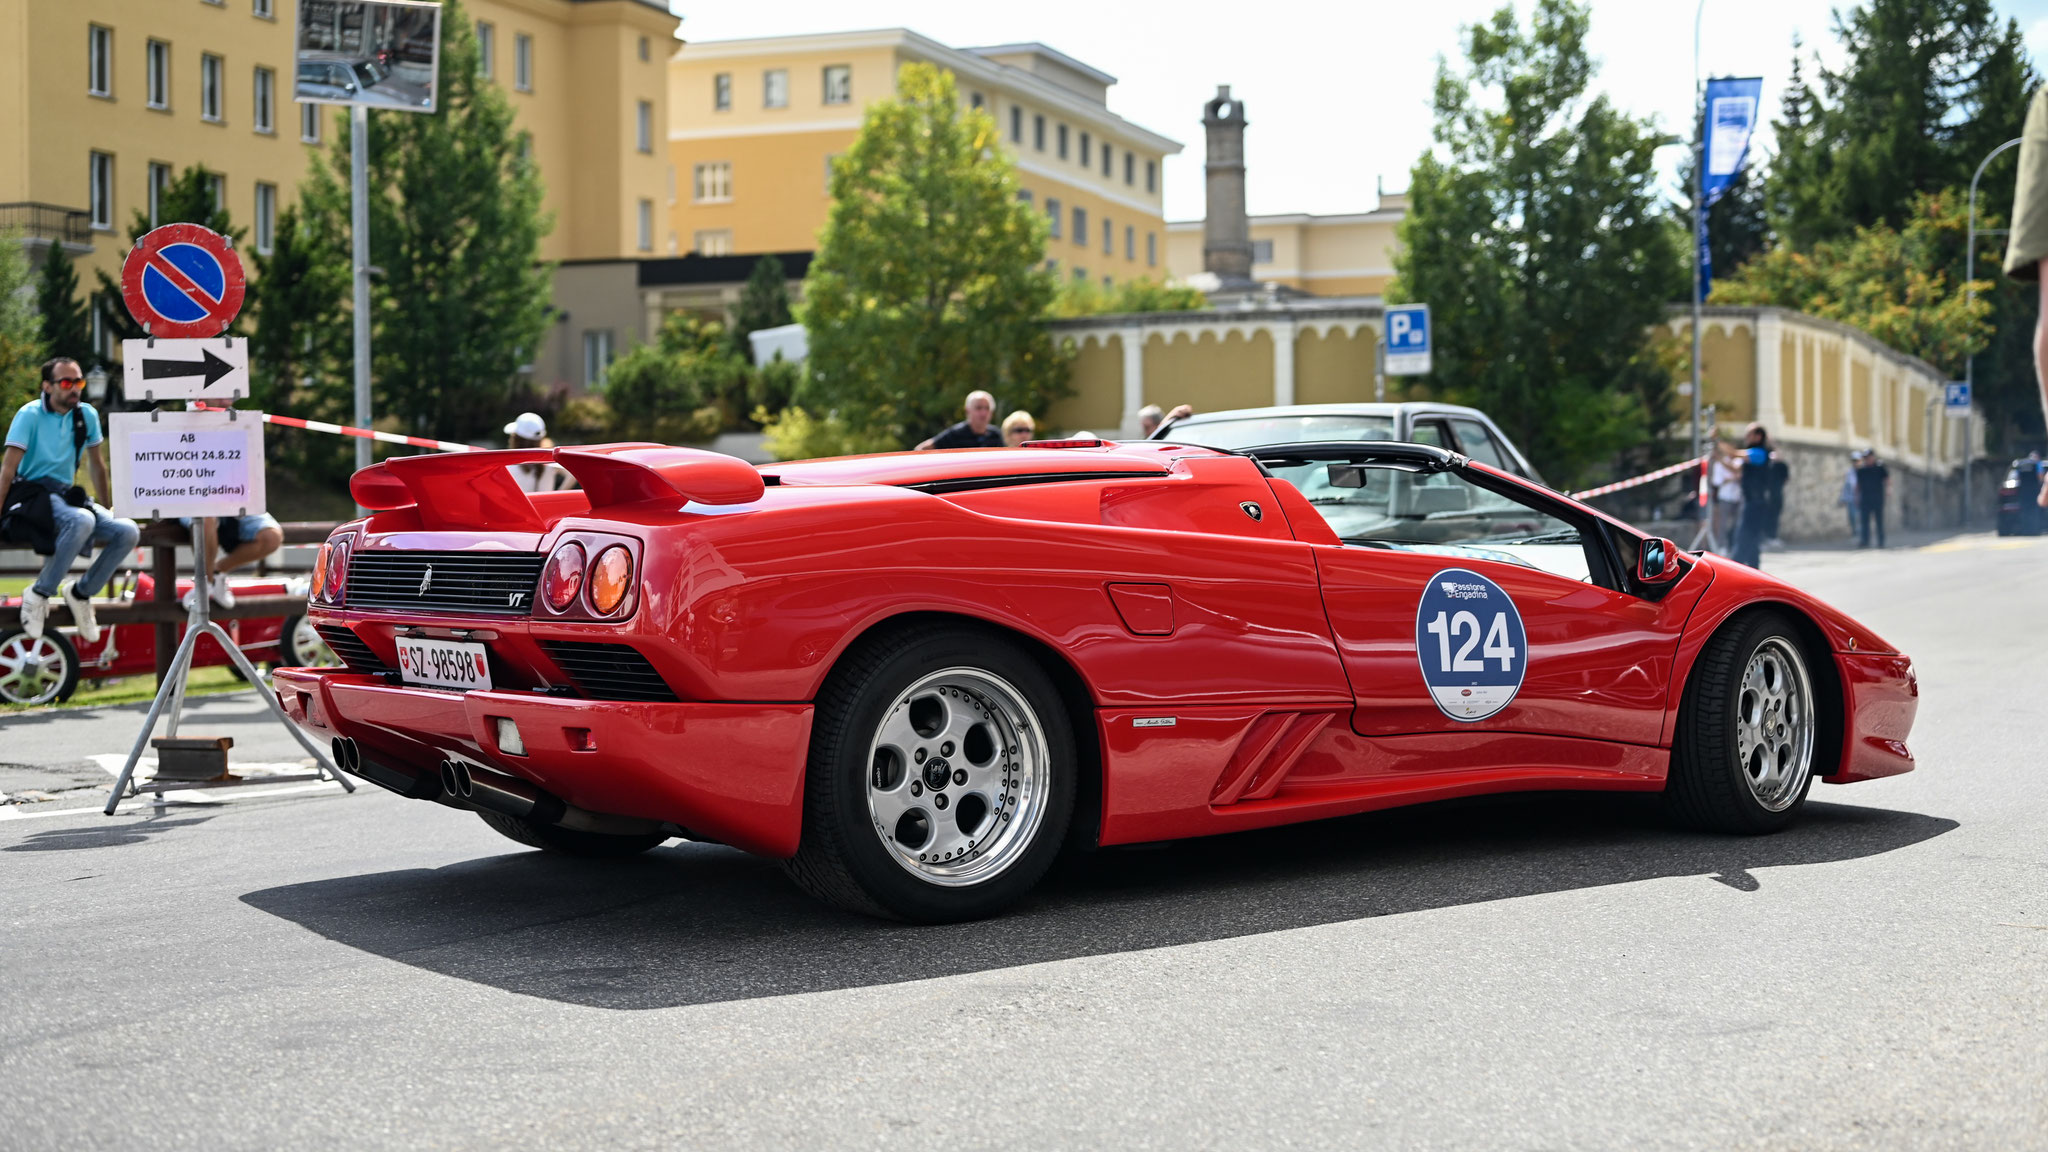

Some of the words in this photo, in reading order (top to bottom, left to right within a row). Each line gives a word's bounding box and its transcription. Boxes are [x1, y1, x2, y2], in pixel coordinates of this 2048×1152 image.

[1390, 313, 1411, 346] P
[180, 433, 196, 443] AB
[135, 450, 199, 461] MITTWOCH
[201, 450, 241, 460] 24.8.22
[162, 468, 193, 479] 07:00
[195, 468, 216, 478] Uhr
[134, 486, 186, 499] (Passione
[189, 484, 245, 497] Engiadina)
[1453, 582, 1487, 591] Passione
[509, 593, 525, 607] VT
[1455, 590, 1488, 600] Engadina
[1427, 610, 1516, 672] 124
